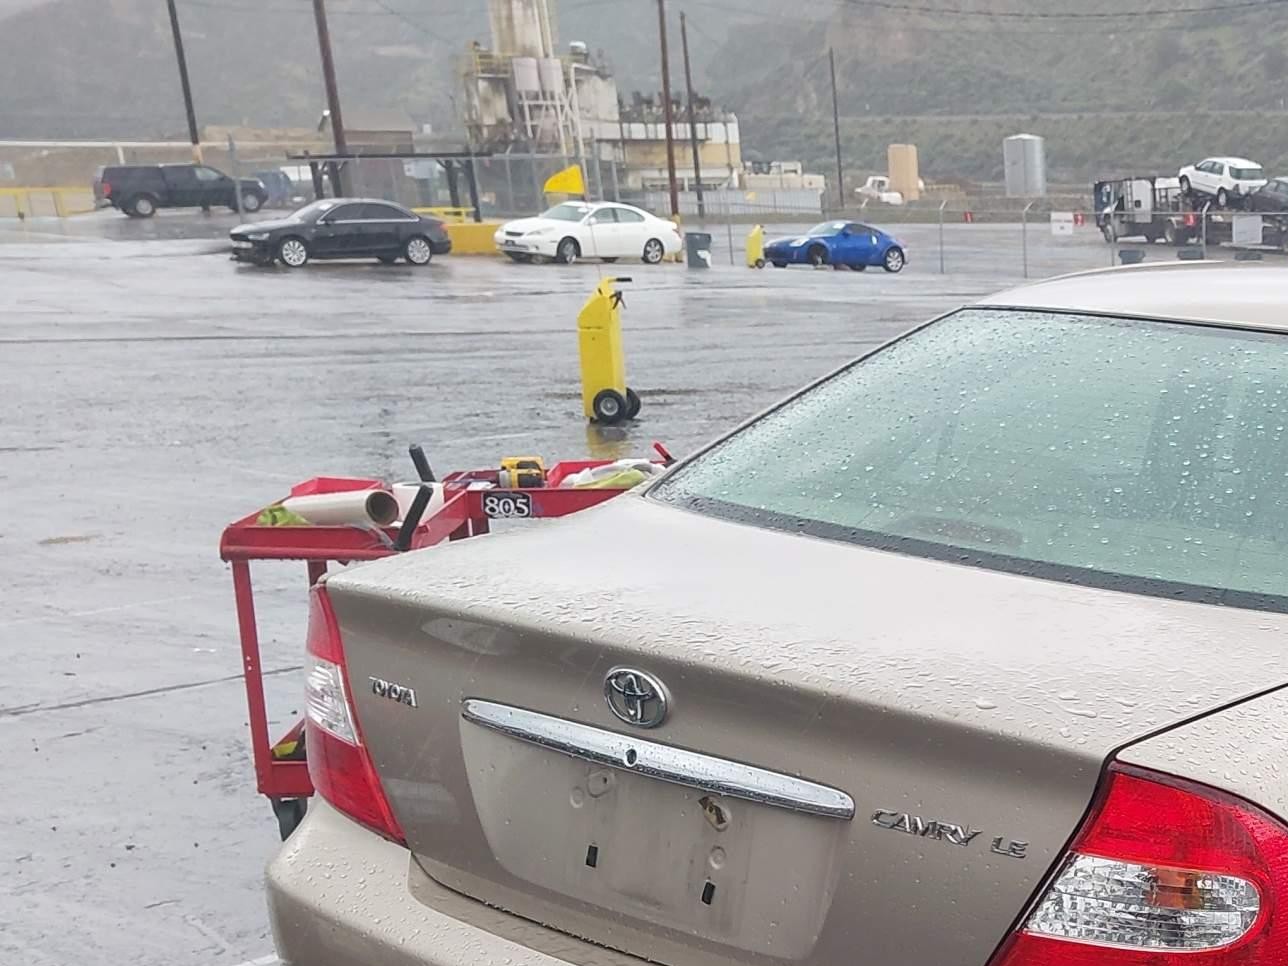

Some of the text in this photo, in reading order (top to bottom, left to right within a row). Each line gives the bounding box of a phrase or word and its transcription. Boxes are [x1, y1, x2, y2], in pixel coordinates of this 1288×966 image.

[485, 496, 529, 517] 805
[368, 676, 418, 708] TOYOTA
[871, 808, 1029, 859] CAMRY LE
